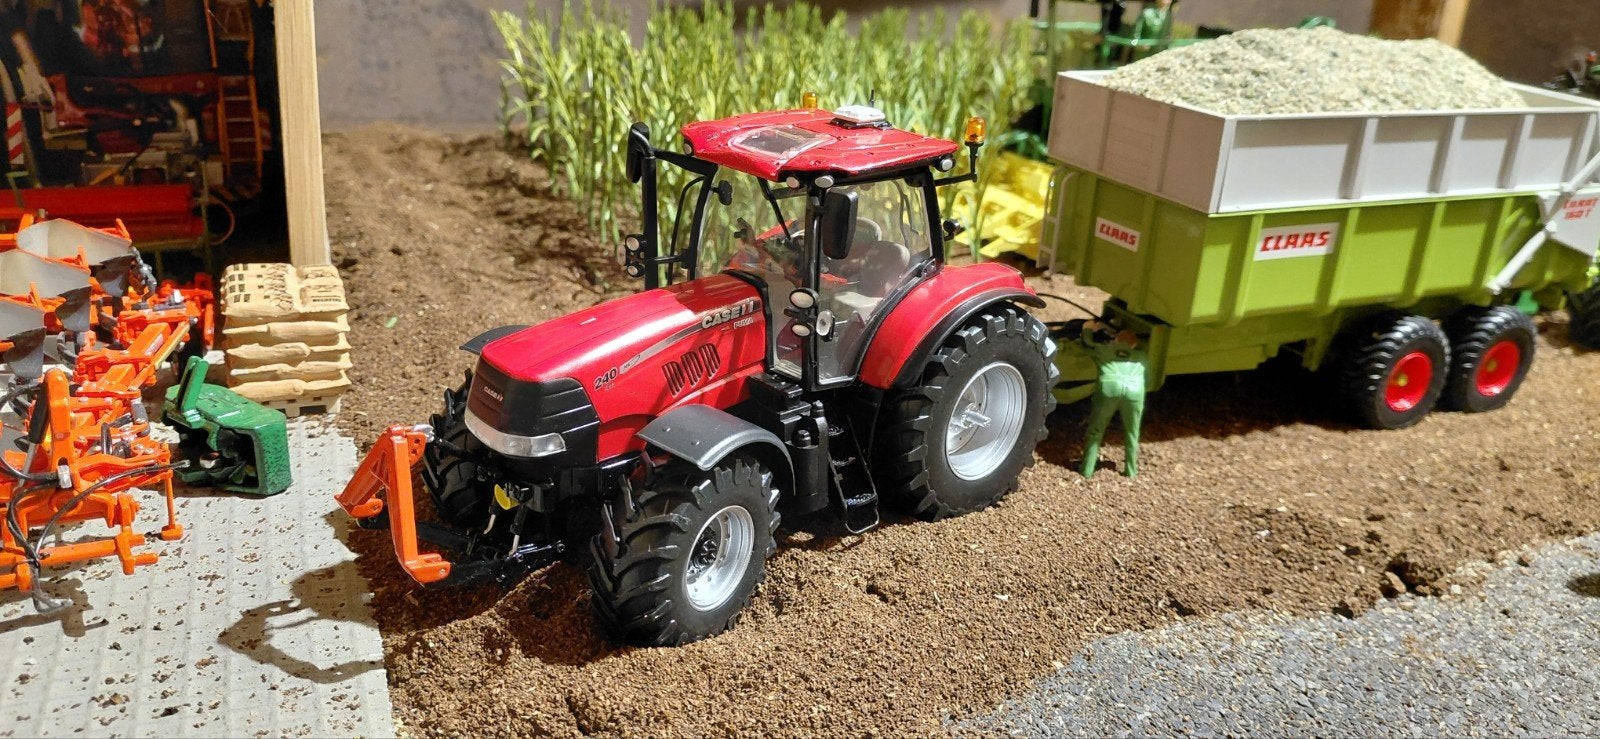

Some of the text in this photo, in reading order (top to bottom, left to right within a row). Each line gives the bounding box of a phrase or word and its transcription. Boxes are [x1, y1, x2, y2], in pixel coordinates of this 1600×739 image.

[1099, 223, 1137, 246] CLAAS
[1260, 231, 1330, 252] CLAAS
[702, 305, 742, 329] CASE
[594, 367, 617, 391] 240
